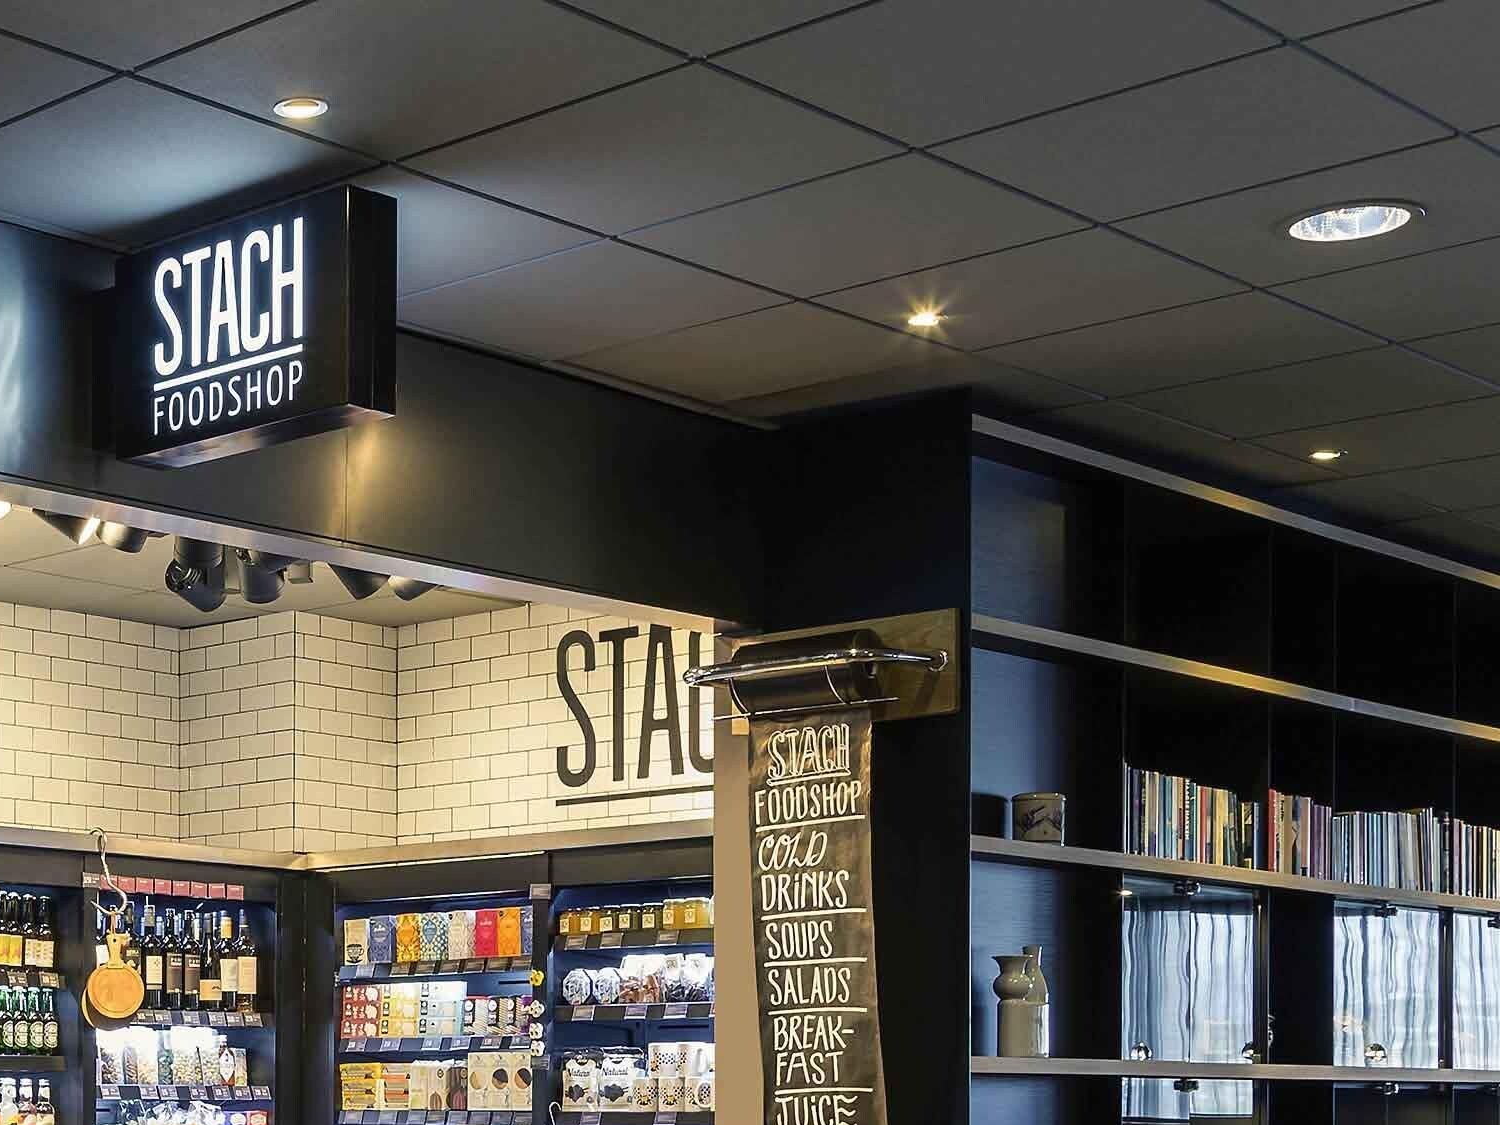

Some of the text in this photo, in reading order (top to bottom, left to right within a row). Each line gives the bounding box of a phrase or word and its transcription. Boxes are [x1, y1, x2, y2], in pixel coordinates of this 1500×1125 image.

[154, 216, 304, 376] STACH
[152, 360, 304, 437] FOODSHOP
[766, 722, 852, 784] STACH
[754, 779, 863, 828] FOODSHOP
[756, 830, 829, 872] COLD
[764, 920, 834, 961] SOUPS
[767, 966, 852, 1008] SALADS
[773, 1014, 855, 1052] BREAK-
[775, 1051, 844, 1087] FAST
